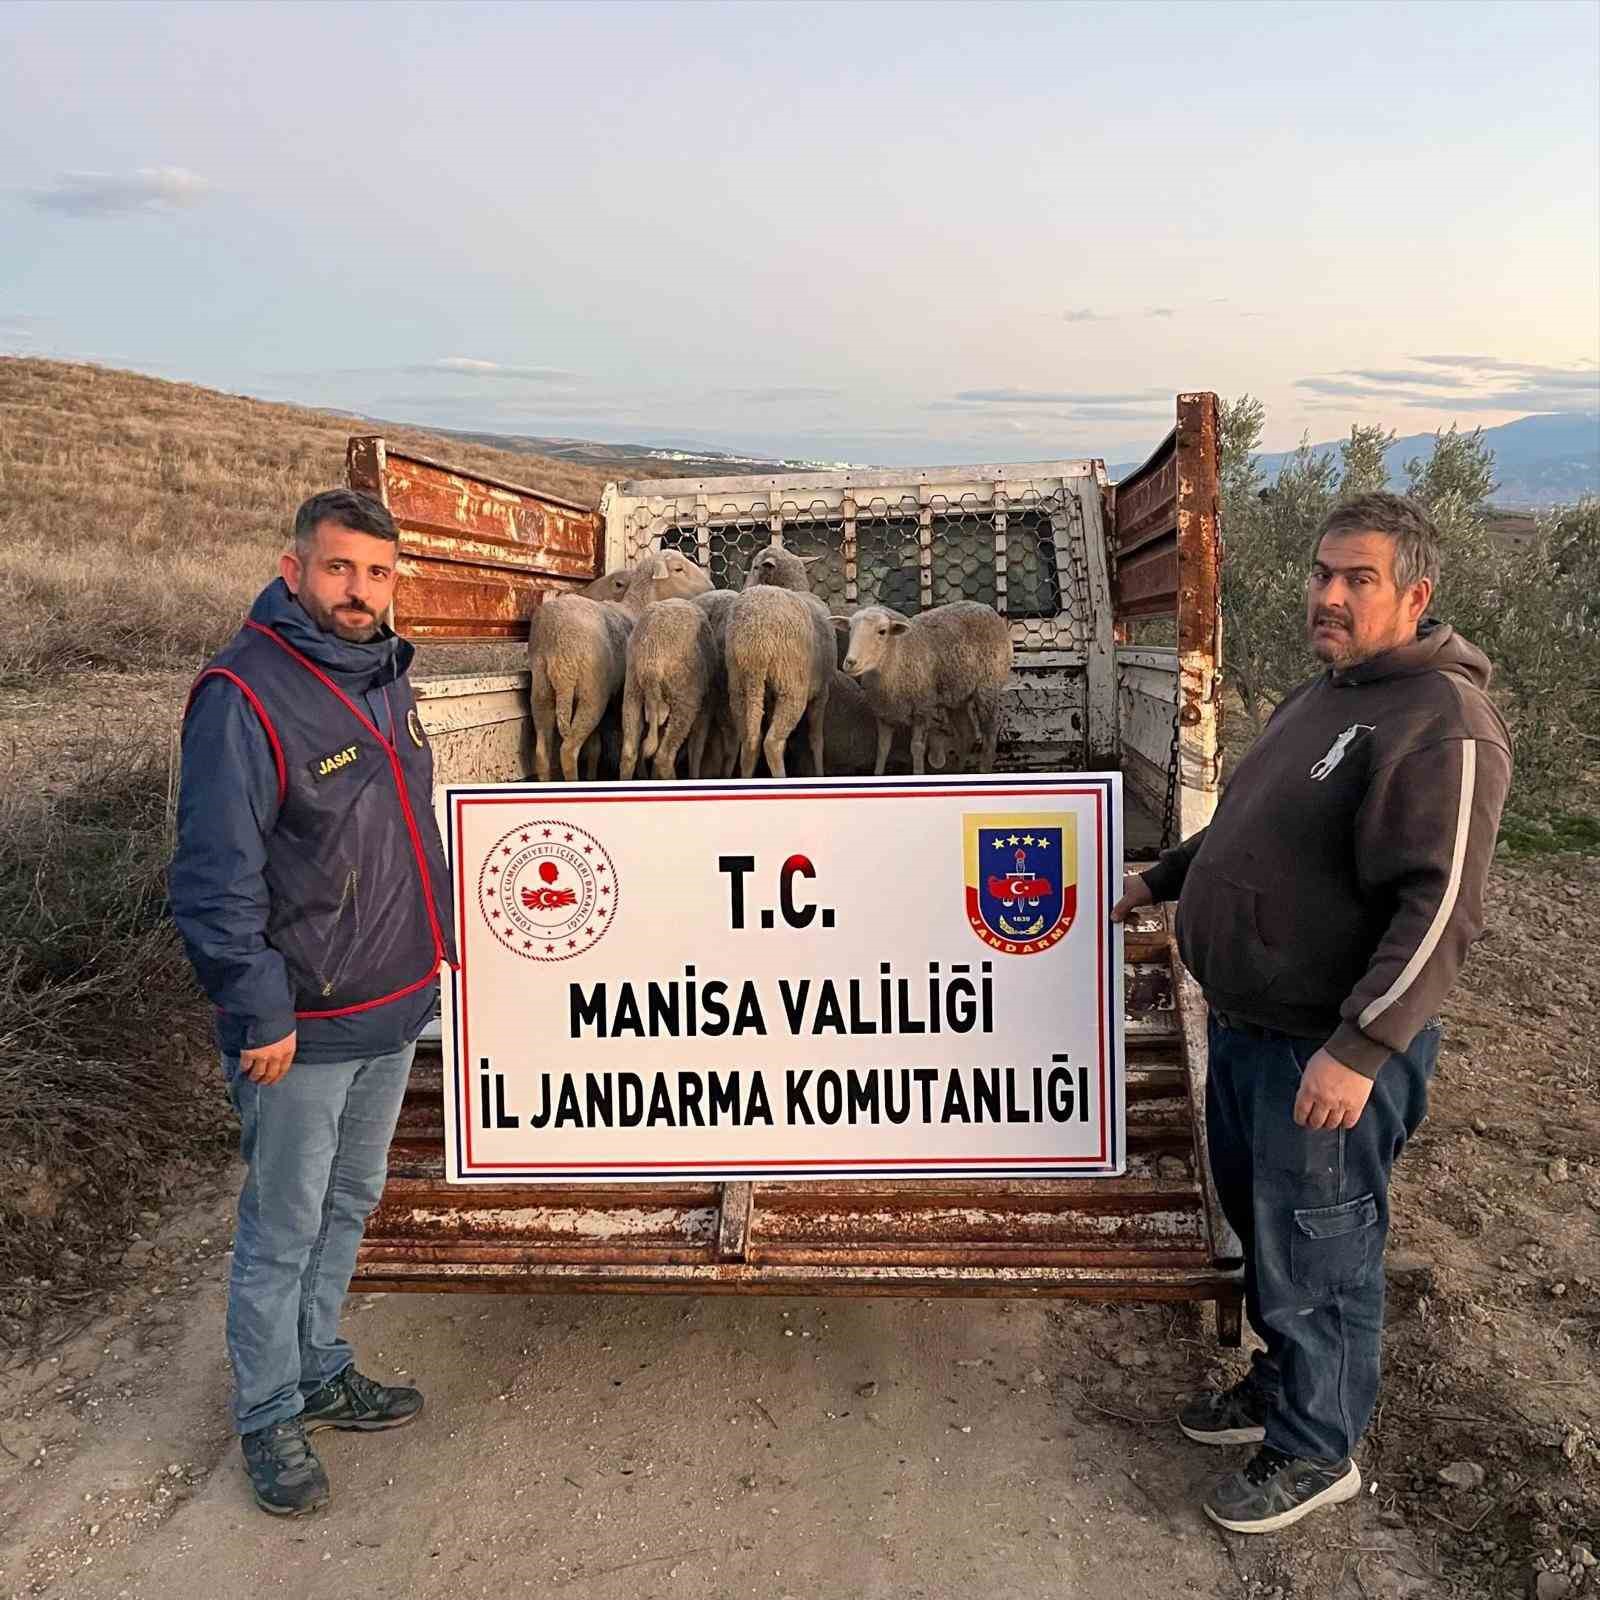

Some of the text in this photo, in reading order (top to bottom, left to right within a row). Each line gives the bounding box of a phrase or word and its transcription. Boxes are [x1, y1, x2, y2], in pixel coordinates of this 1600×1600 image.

[319, 746, 357, 775] JASAT
[719, 855, 835, 929] T.C.
[970, 915, 1072, 953] JANDARMA
[570, 962, 993, 1038] MANİSA VALİLİĞİ
[481, 1054, 1089, 1129] İL JANDARMA KOMUTANLIĞI
